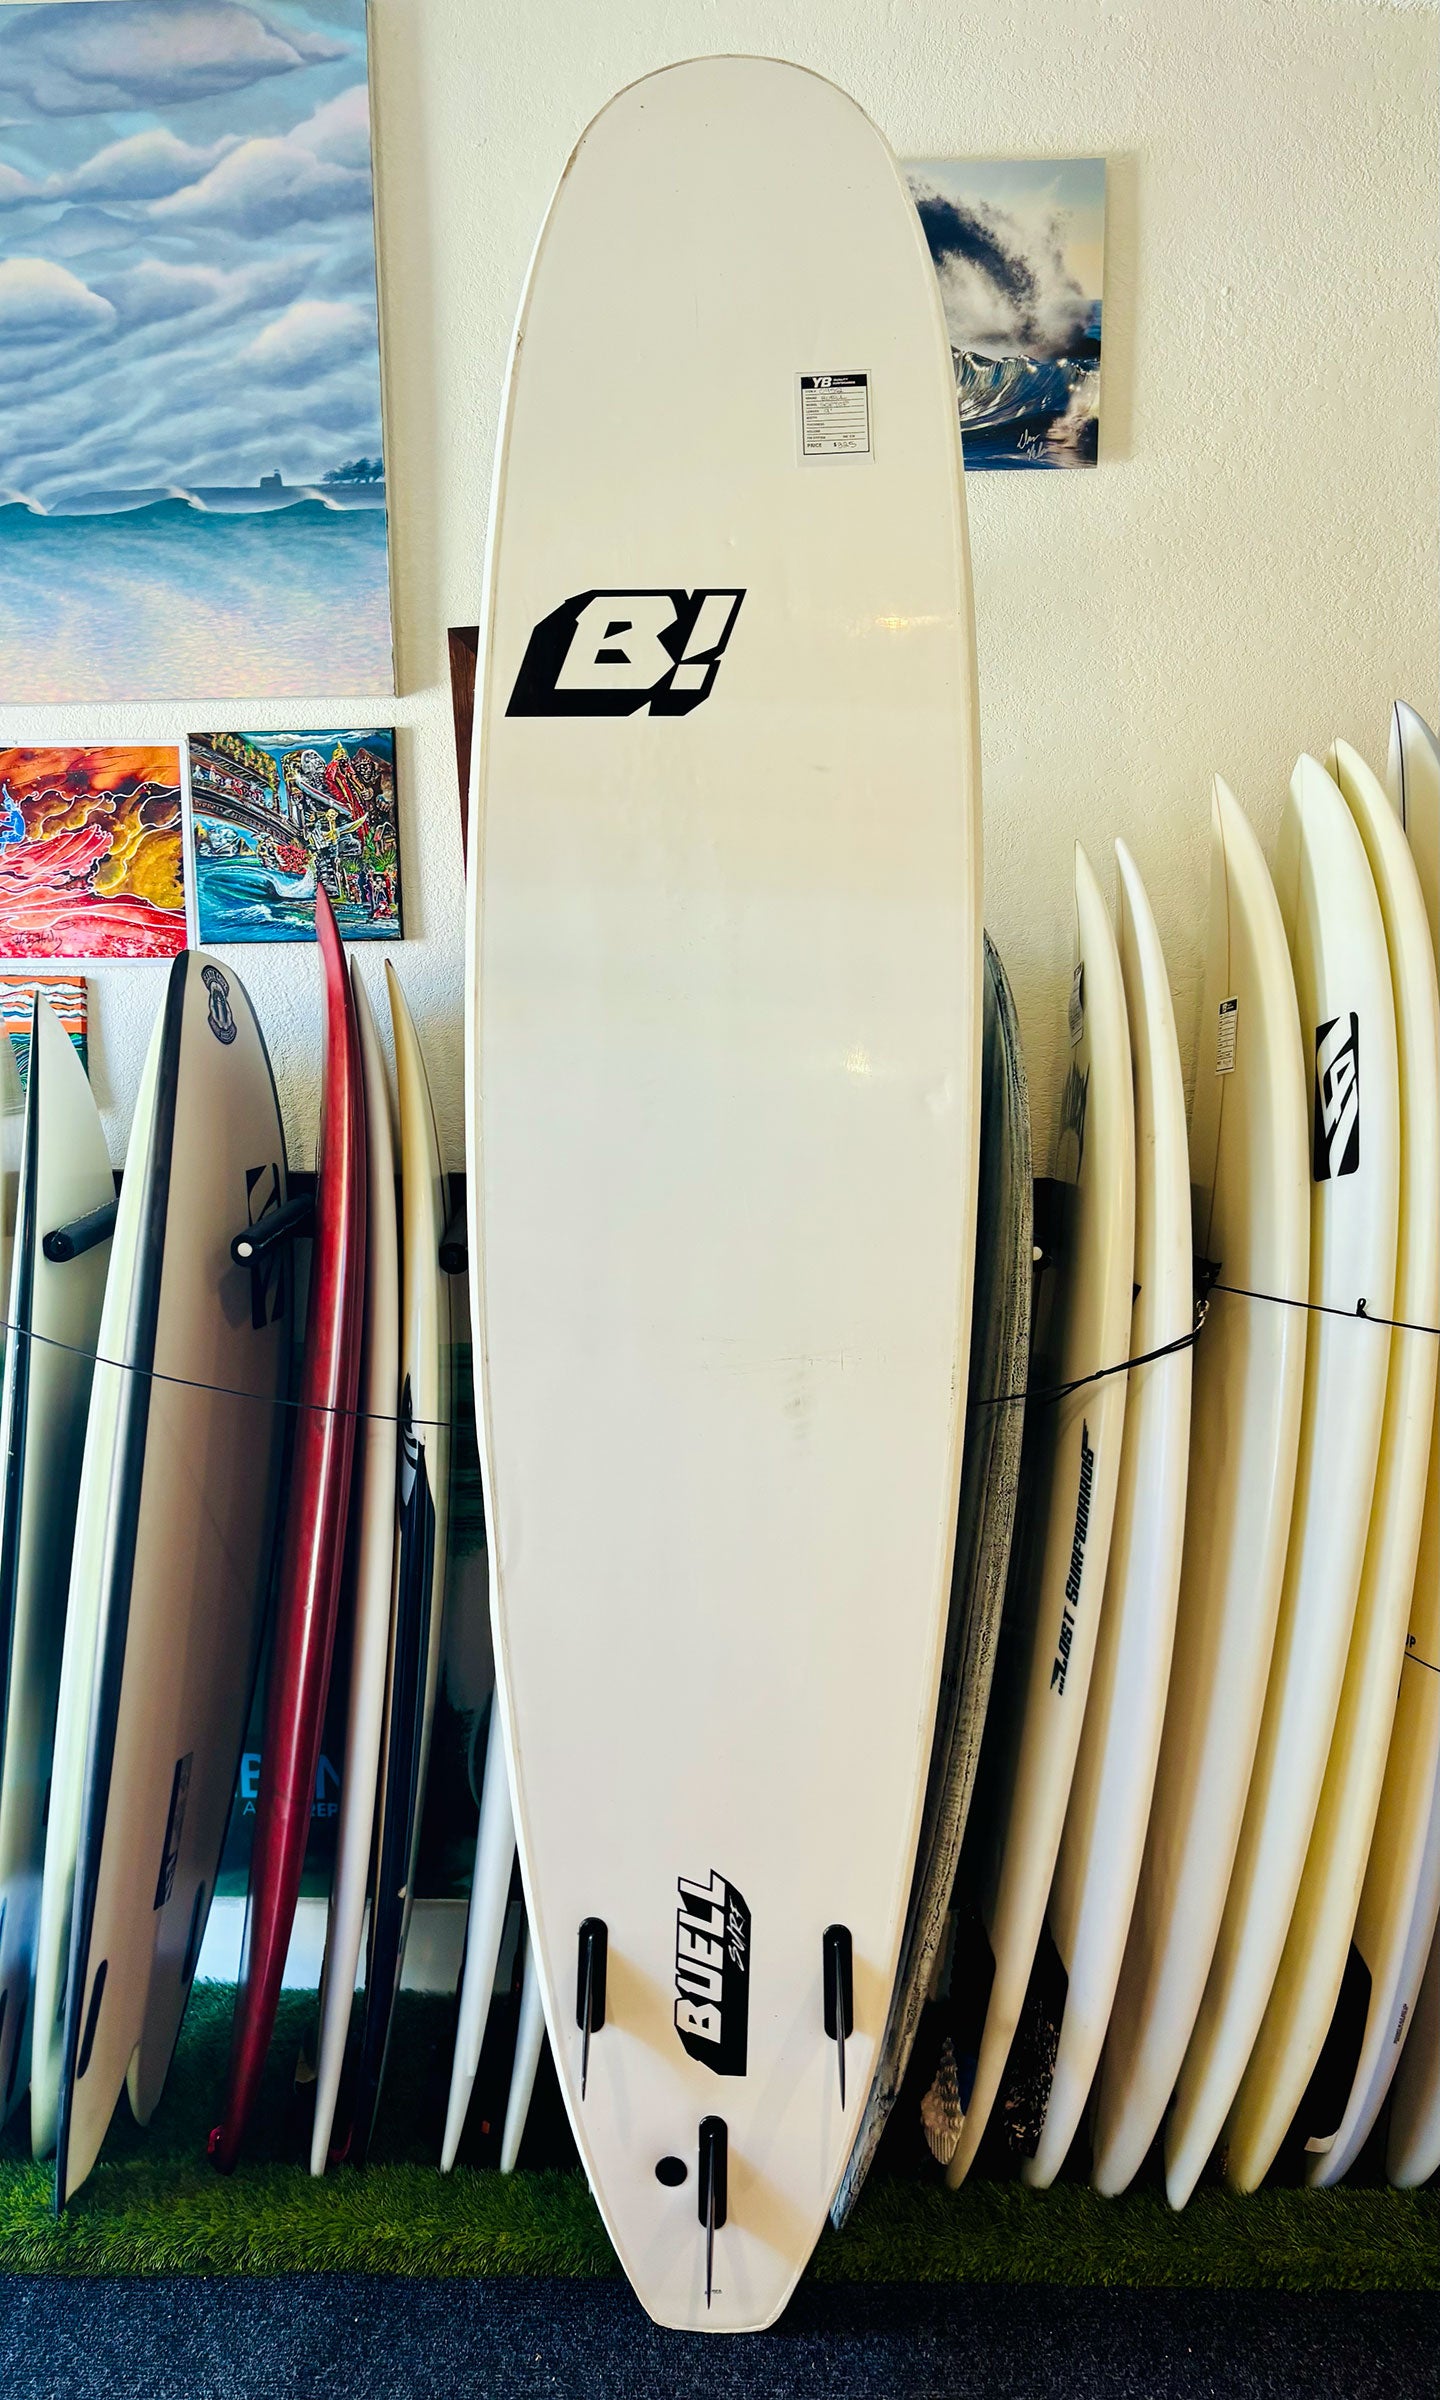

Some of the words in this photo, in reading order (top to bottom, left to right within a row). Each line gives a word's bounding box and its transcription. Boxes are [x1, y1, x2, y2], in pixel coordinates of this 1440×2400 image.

[812, 377, 832, 388] YB
[675, 1869, 726, 2044] BUELL
[727, 1896, 746, 1972] SURF
